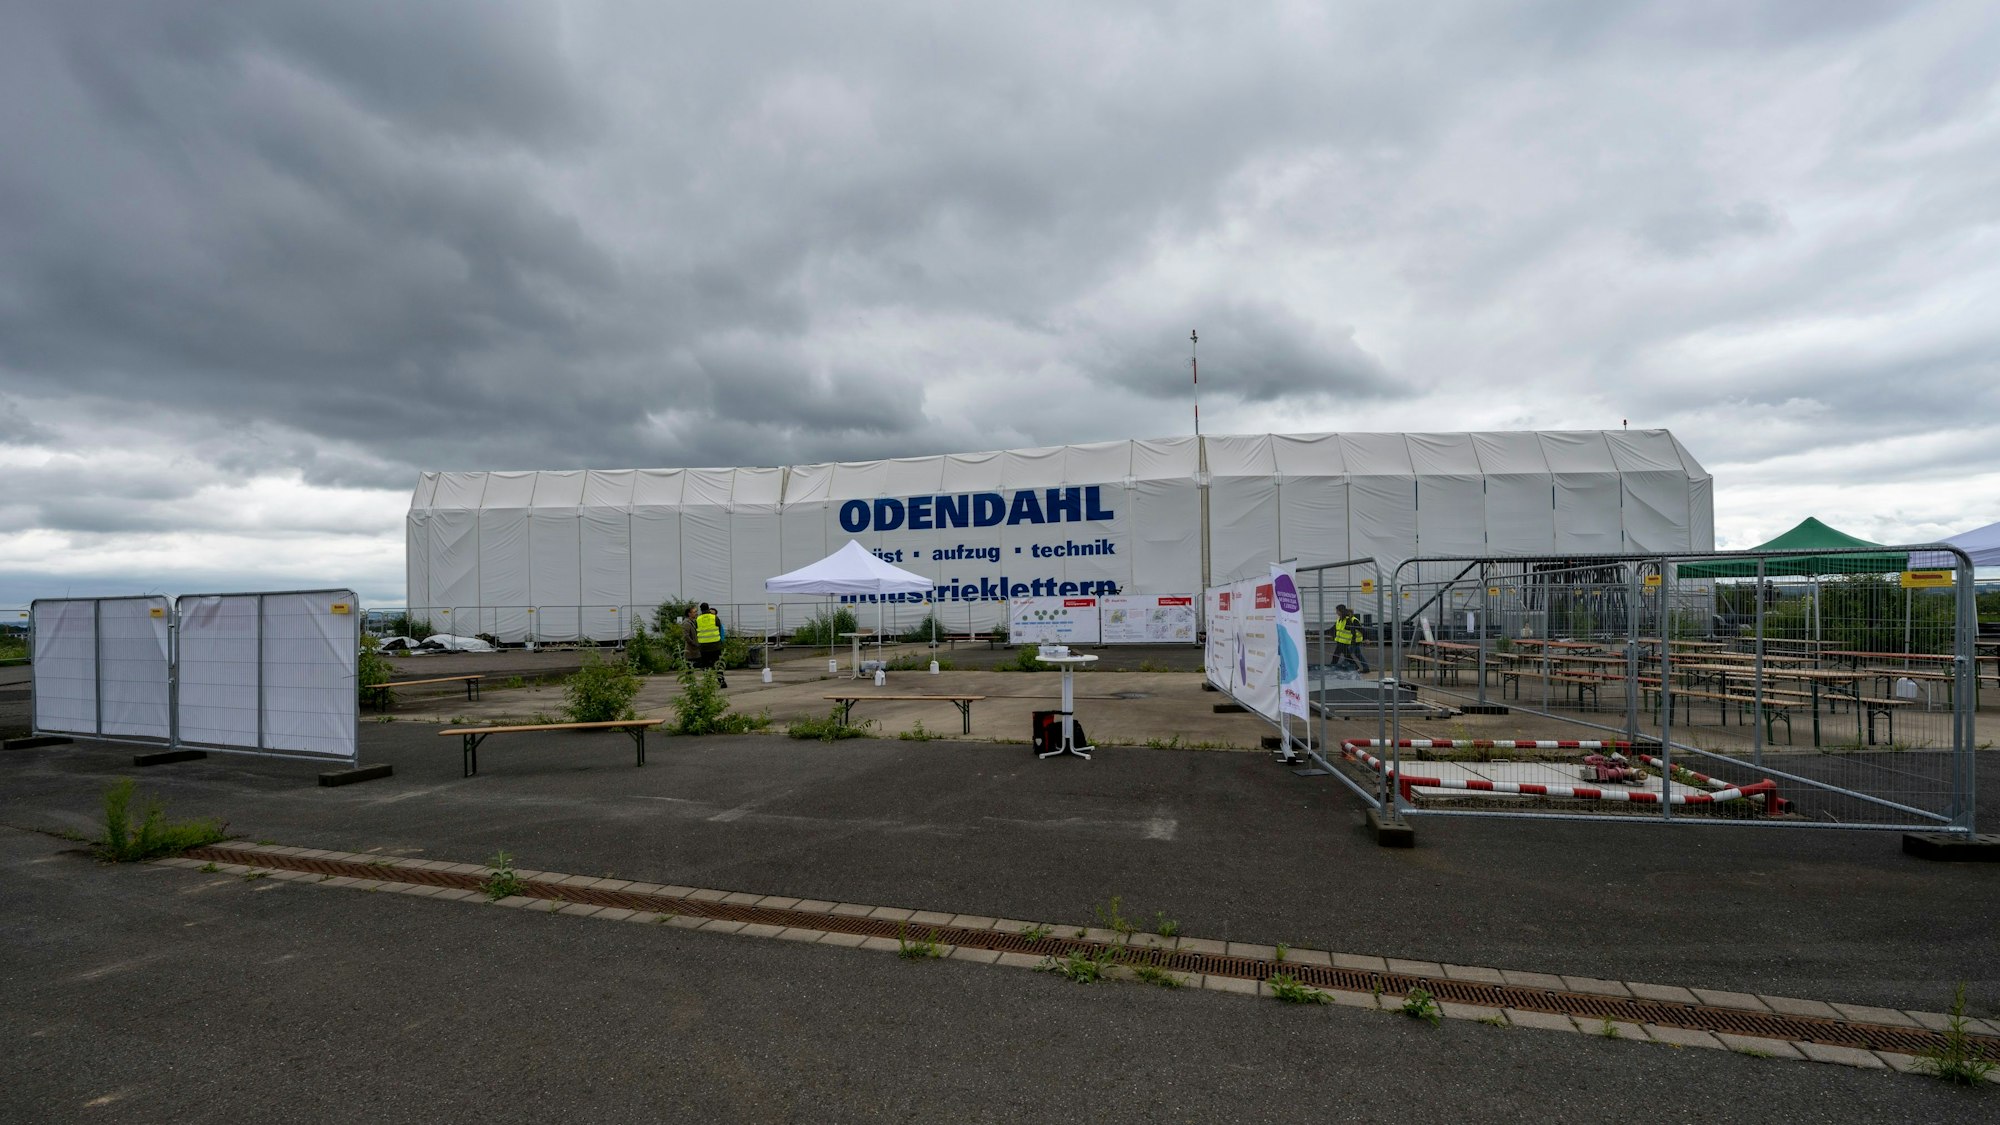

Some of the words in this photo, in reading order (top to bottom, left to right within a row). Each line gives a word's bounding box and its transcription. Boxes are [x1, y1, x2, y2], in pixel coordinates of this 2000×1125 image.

[839, 485, 1114, 533] ODENDAHL
[932, 543, 1001, 563] aufzug
[1031, 538, 1116, 559] technik
